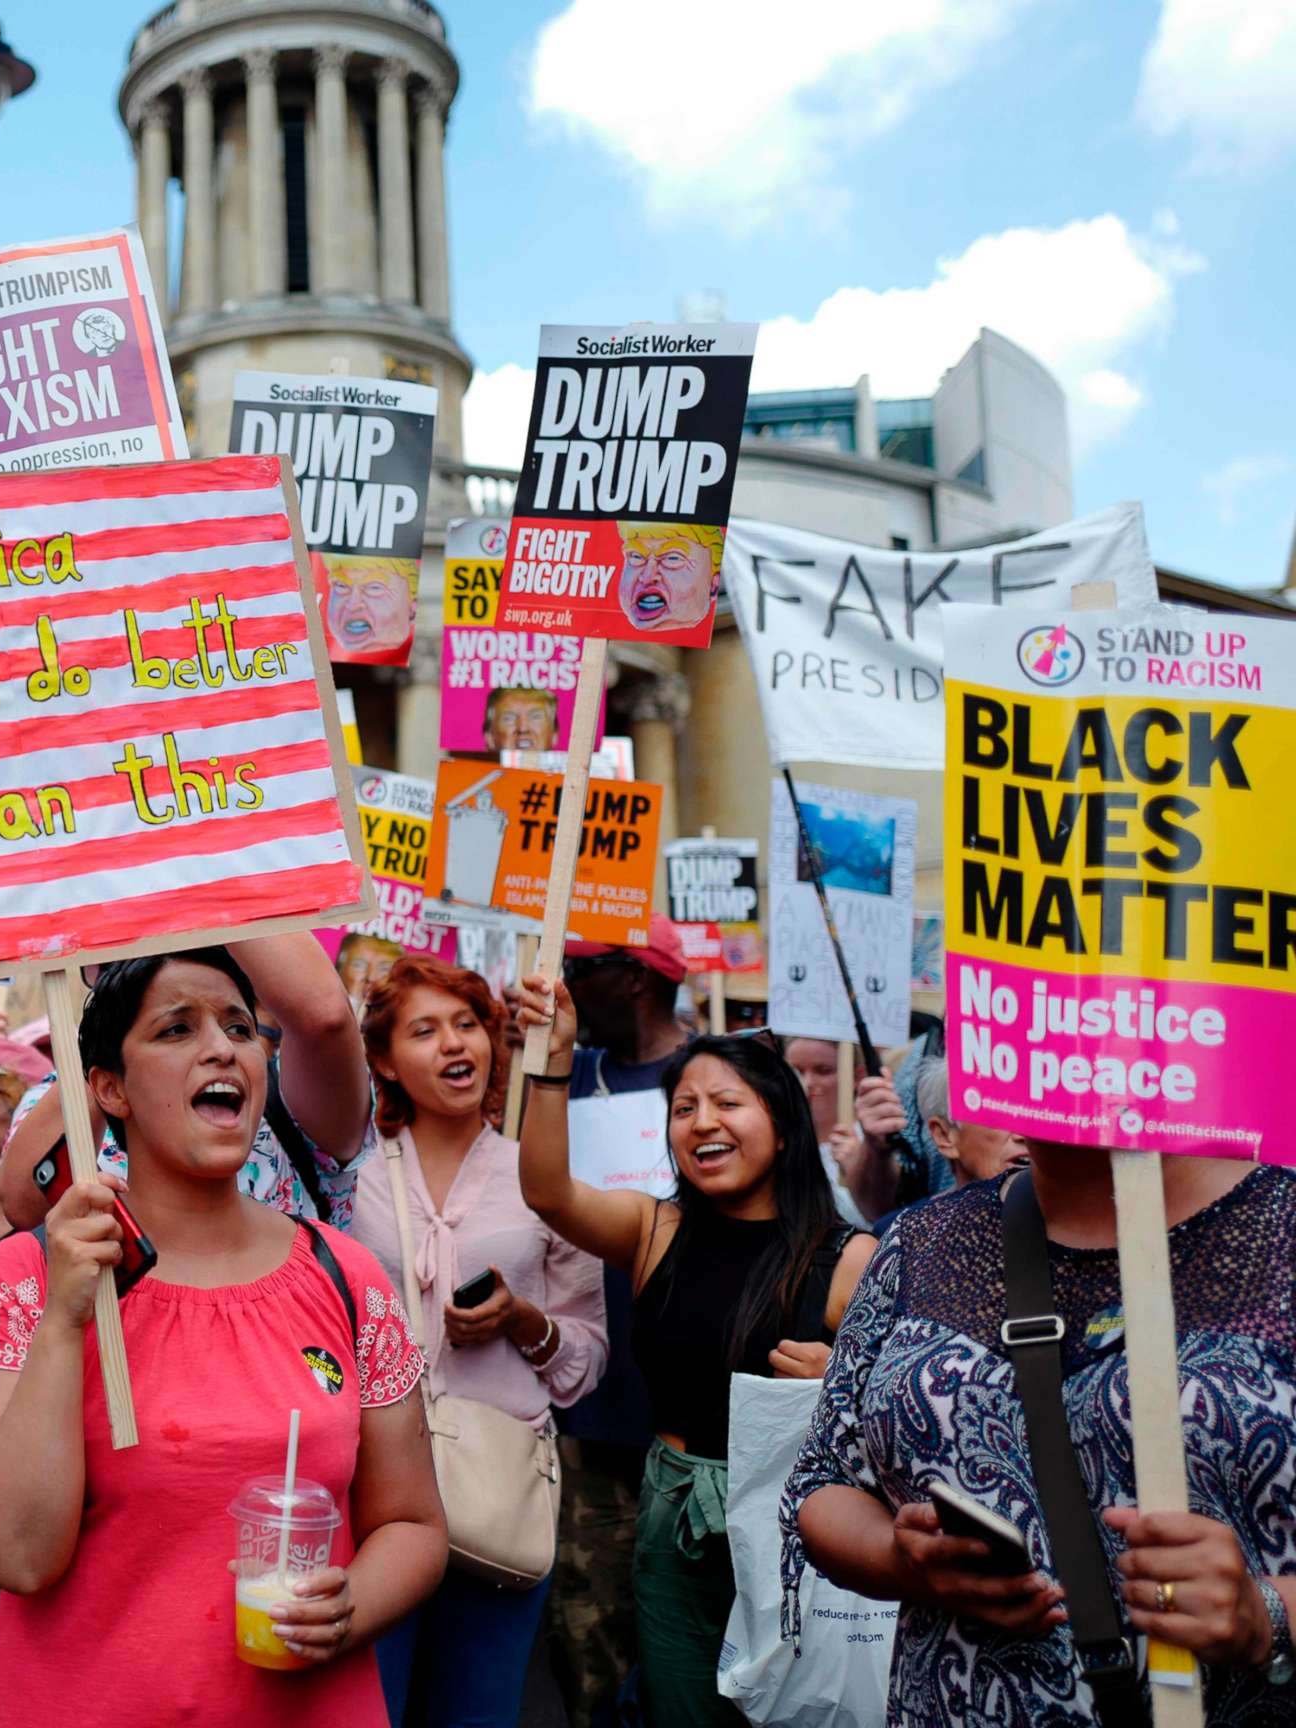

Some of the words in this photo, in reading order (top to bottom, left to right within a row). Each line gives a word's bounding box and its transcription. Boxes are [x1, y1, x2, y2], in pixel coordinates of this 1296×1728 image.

[576, 337, 650, 356] Socialist
[650, 334, 716, 355] Worker
[270, 384, 340, 402] Socialist
[341, 387, 402, 408] Worker
[539, 365, 706, 439] DUMP
[10, 441, 117, 471] oppression,
[121, 437, 144, 452] no
[240, 409, 395, 481] DUMP
[532, 440, 727, 515] TRUMP
[296, 478, 419, 549] UMP
[514, 527, 591, 563] FIGHT
[509, 560, 616, 599] BIGOTRY
[452, 595, 489, 619] TO
[504, 608, 573, 628] swp.org.uk
[26, 614, 91, 702] do
[124, 593, 298, 690] better
[450, 631, 581, 662] WORLD'S
[1097, 627, 1194, 658] STAND
[1206, 631, 1247, 659] UP
[448, 660, 485, 689] #1
[489, 661, 582, 691] RACIS
[771, 650, 944, 704] PRESID
[1097, 657, 1136, 684] TO
[1146, 659, 1262, 692] RACISM
[962, 693, 1251, 790] BLACK
[113, 731, 265, 826] this
[388, 821, 426, 849] NO
[962, 775, 1202, 873] LIVES
[368, 843, 427, 881] TRU
[671, 857, 743, 887] DUMP
[671, 886, 757, 922] TRUMP
[962, 859, 1296, 971] MATTER
[959, 965, 1018, 1026] No
[1026, 980, 1226, 1046] justice
[959, 1022, 1018, 1083] No
[1030, 1041, 1197, 1102] peace
[1144, 1119, 1263, 1144] @AntiRacismDay
[812, 1607, 849, 1621] reduce
